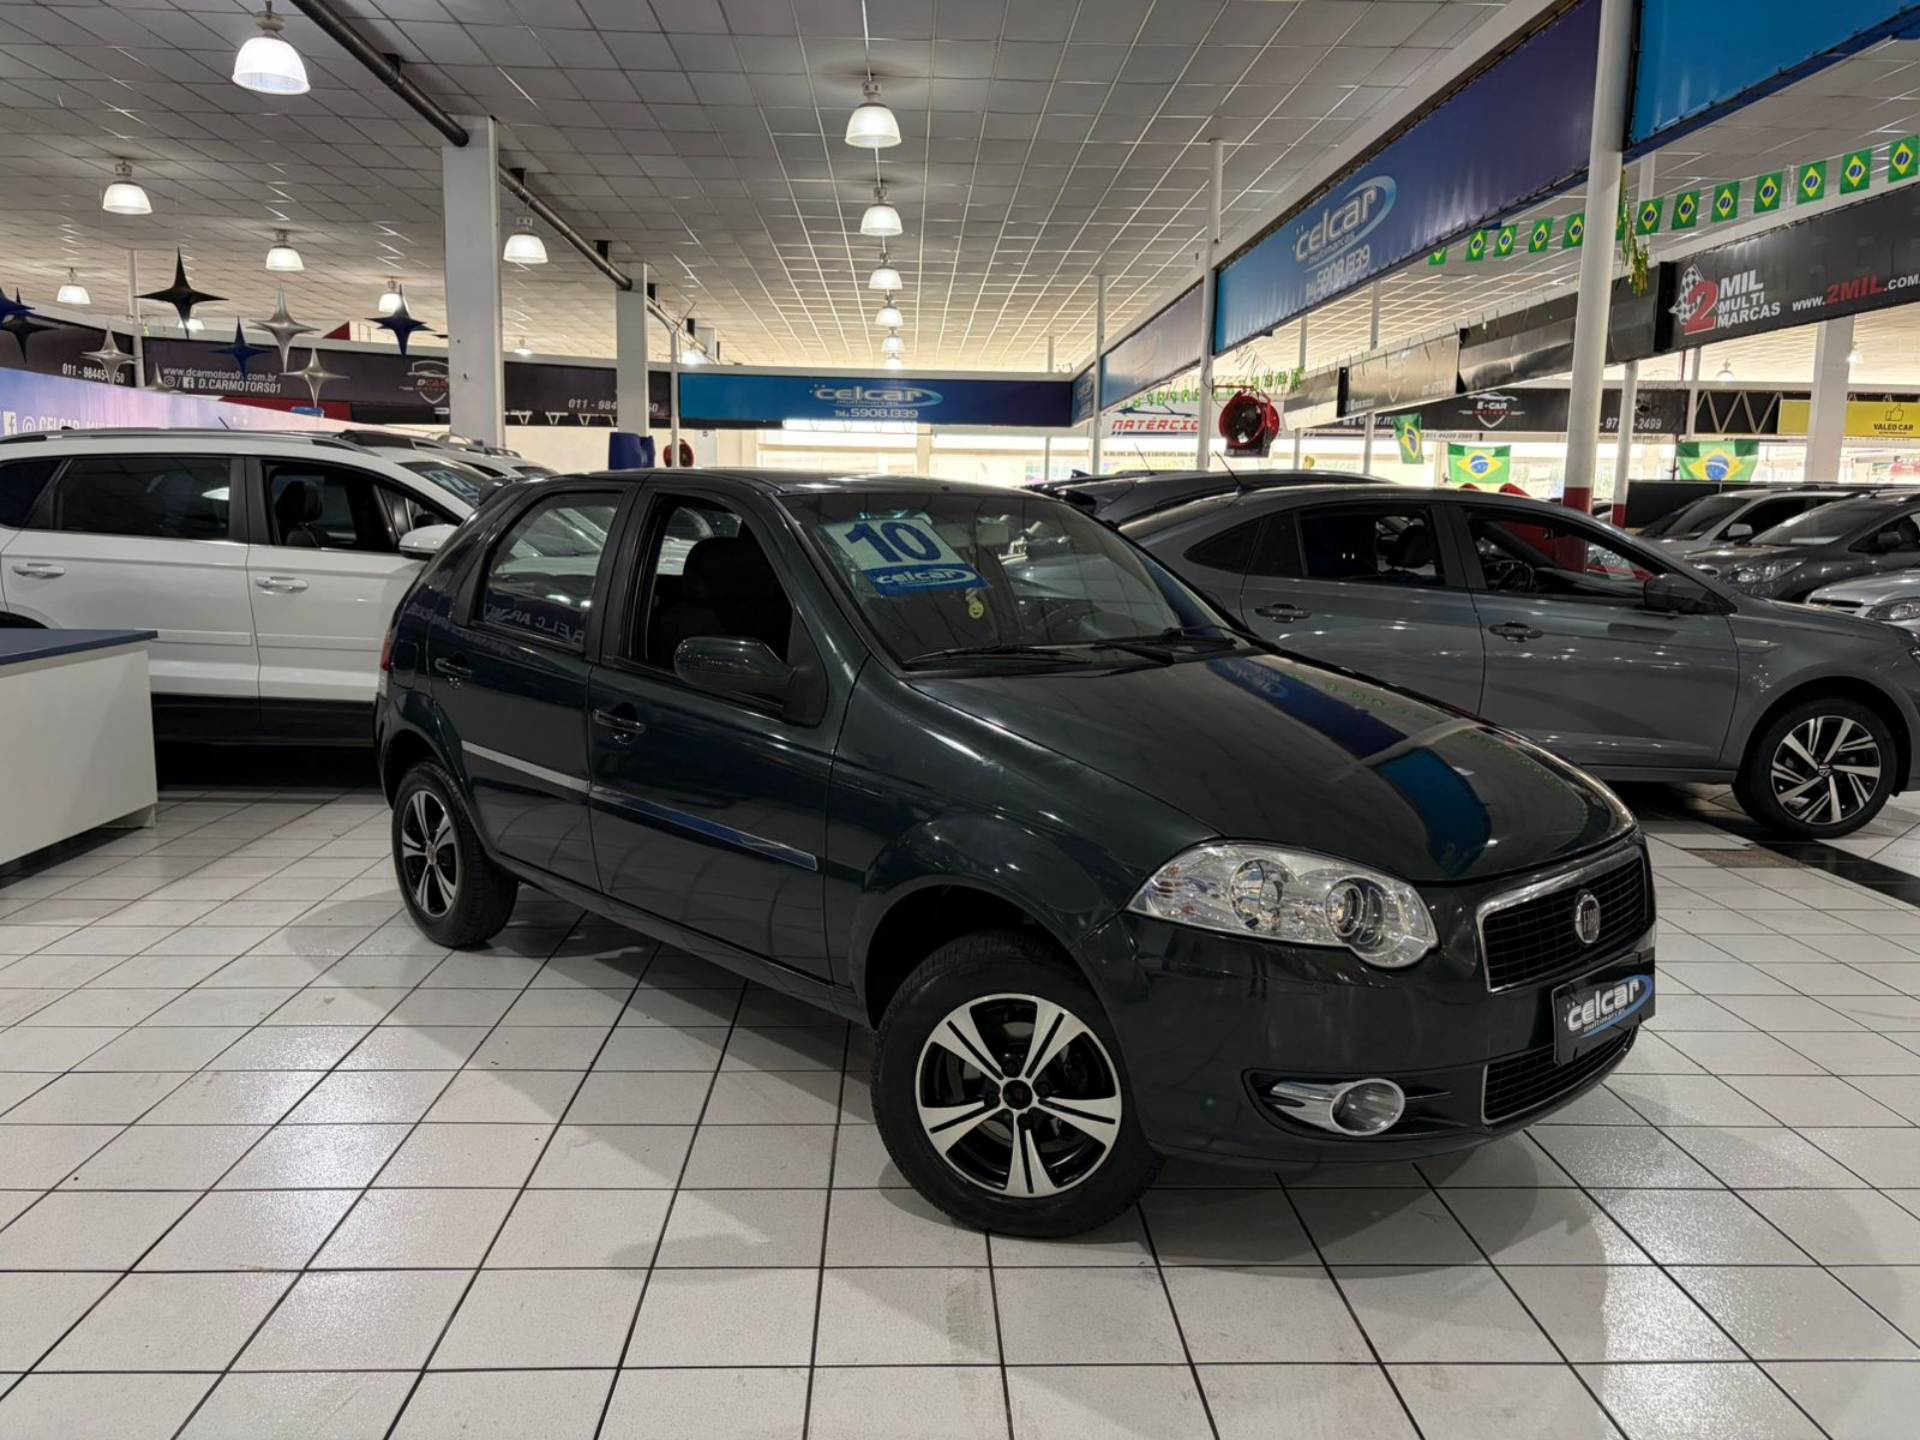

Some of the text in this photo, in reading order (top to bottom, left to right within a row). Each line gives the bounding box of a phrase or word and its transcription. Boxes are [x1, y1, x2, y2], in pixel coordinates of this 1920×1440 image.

[1296, 185, 1377, 262] celcar
[1720, 270, 1764, 299] MIL
[1717, 302, 1781, 329] MARCAS
[1718, 291, 1765, 314] MULTI
[815, 386, 922, 401] celcar
[845, 522, 942, 562] 10
[876, 571, 957, 585] celcar
[1567, 979, 1640, 1032] celcar
